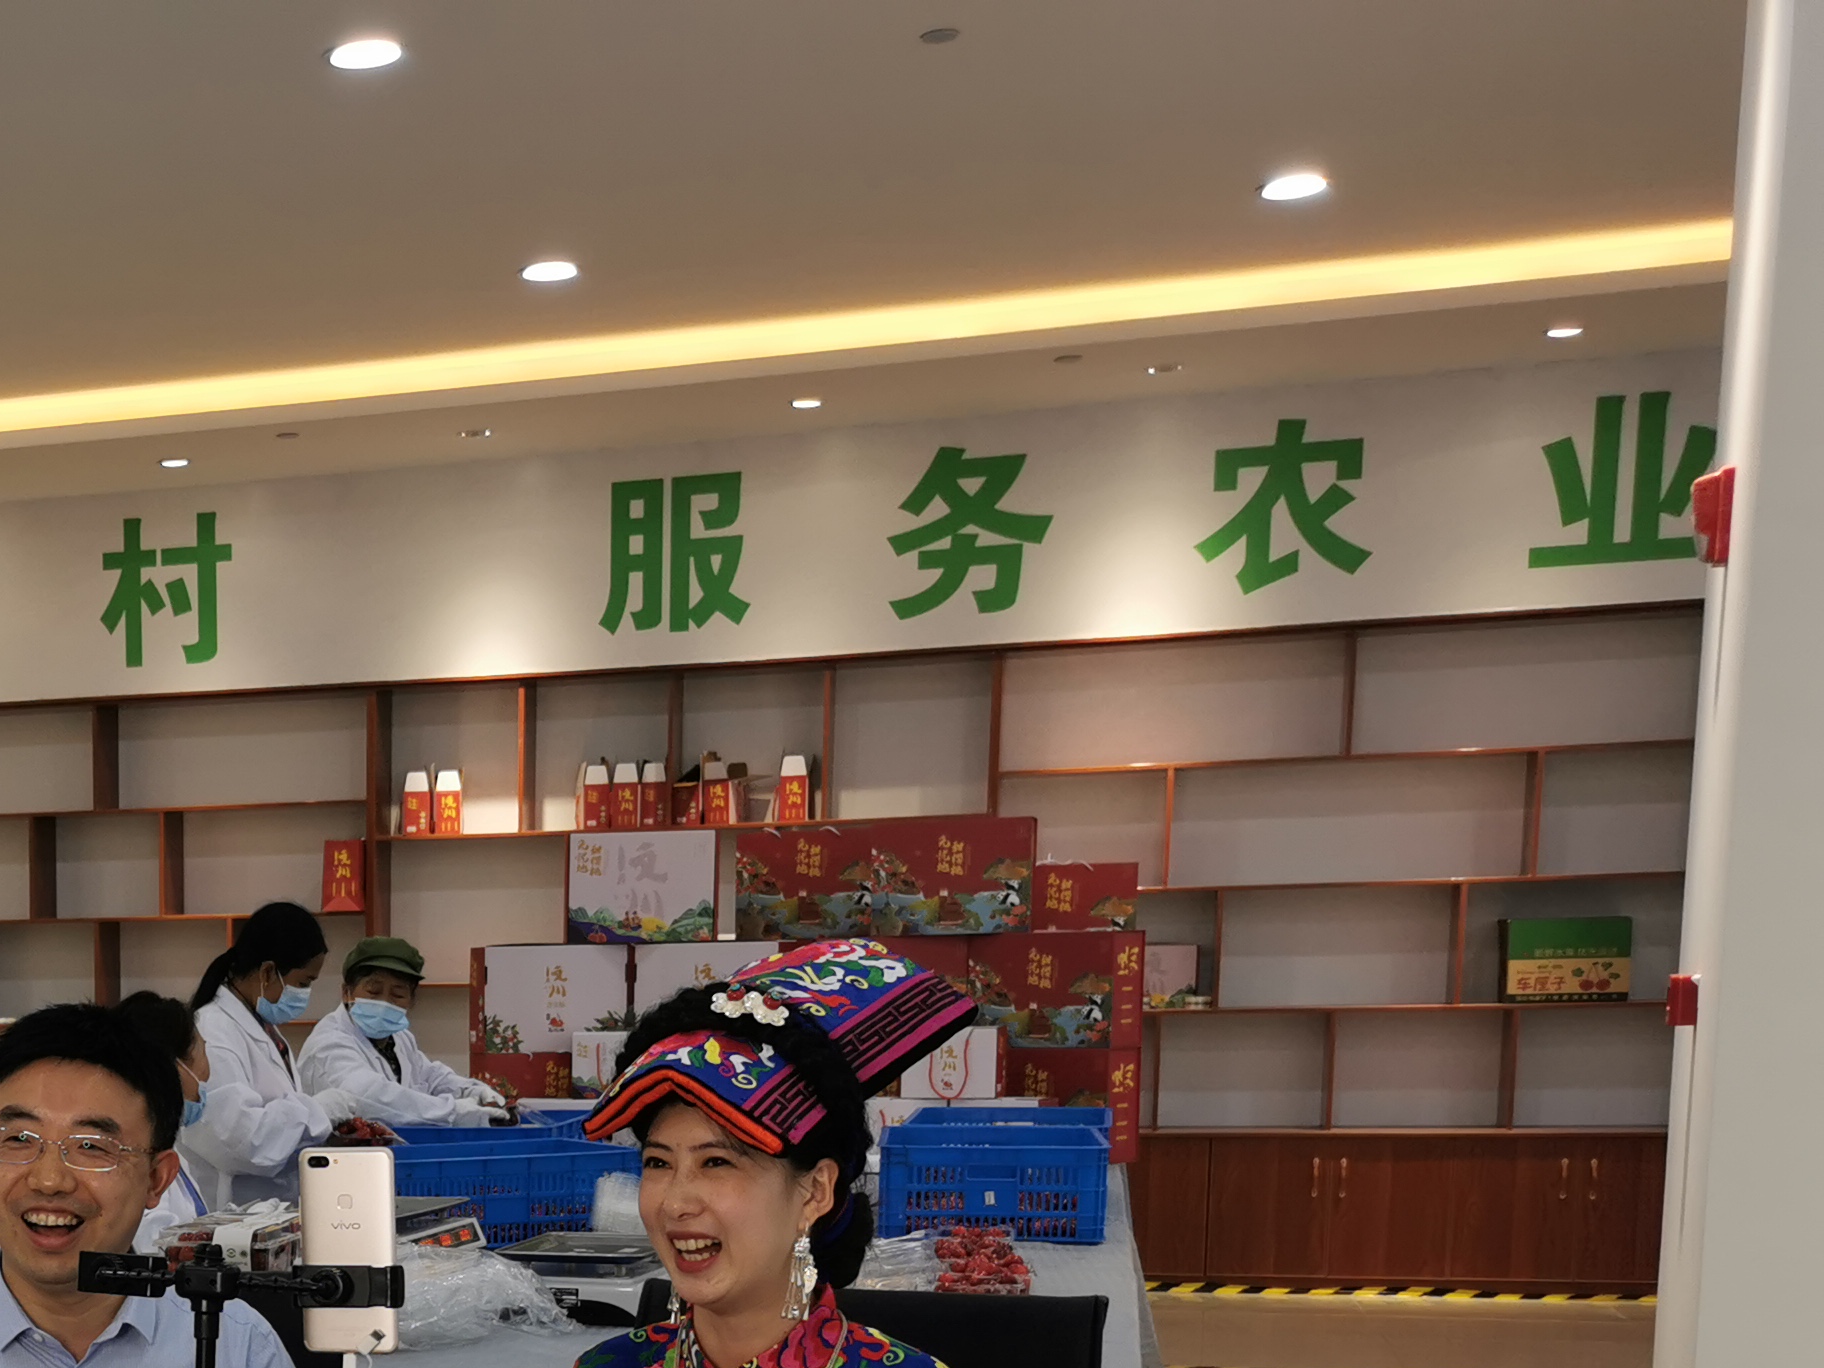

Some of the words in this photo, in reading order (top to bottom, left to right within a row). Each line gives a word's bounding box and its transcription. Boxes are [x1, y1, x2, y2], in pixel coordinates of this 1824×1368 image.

[598, 390, 1719, 635] 服务农业
[330, 1220, 362, 1231] vivo
